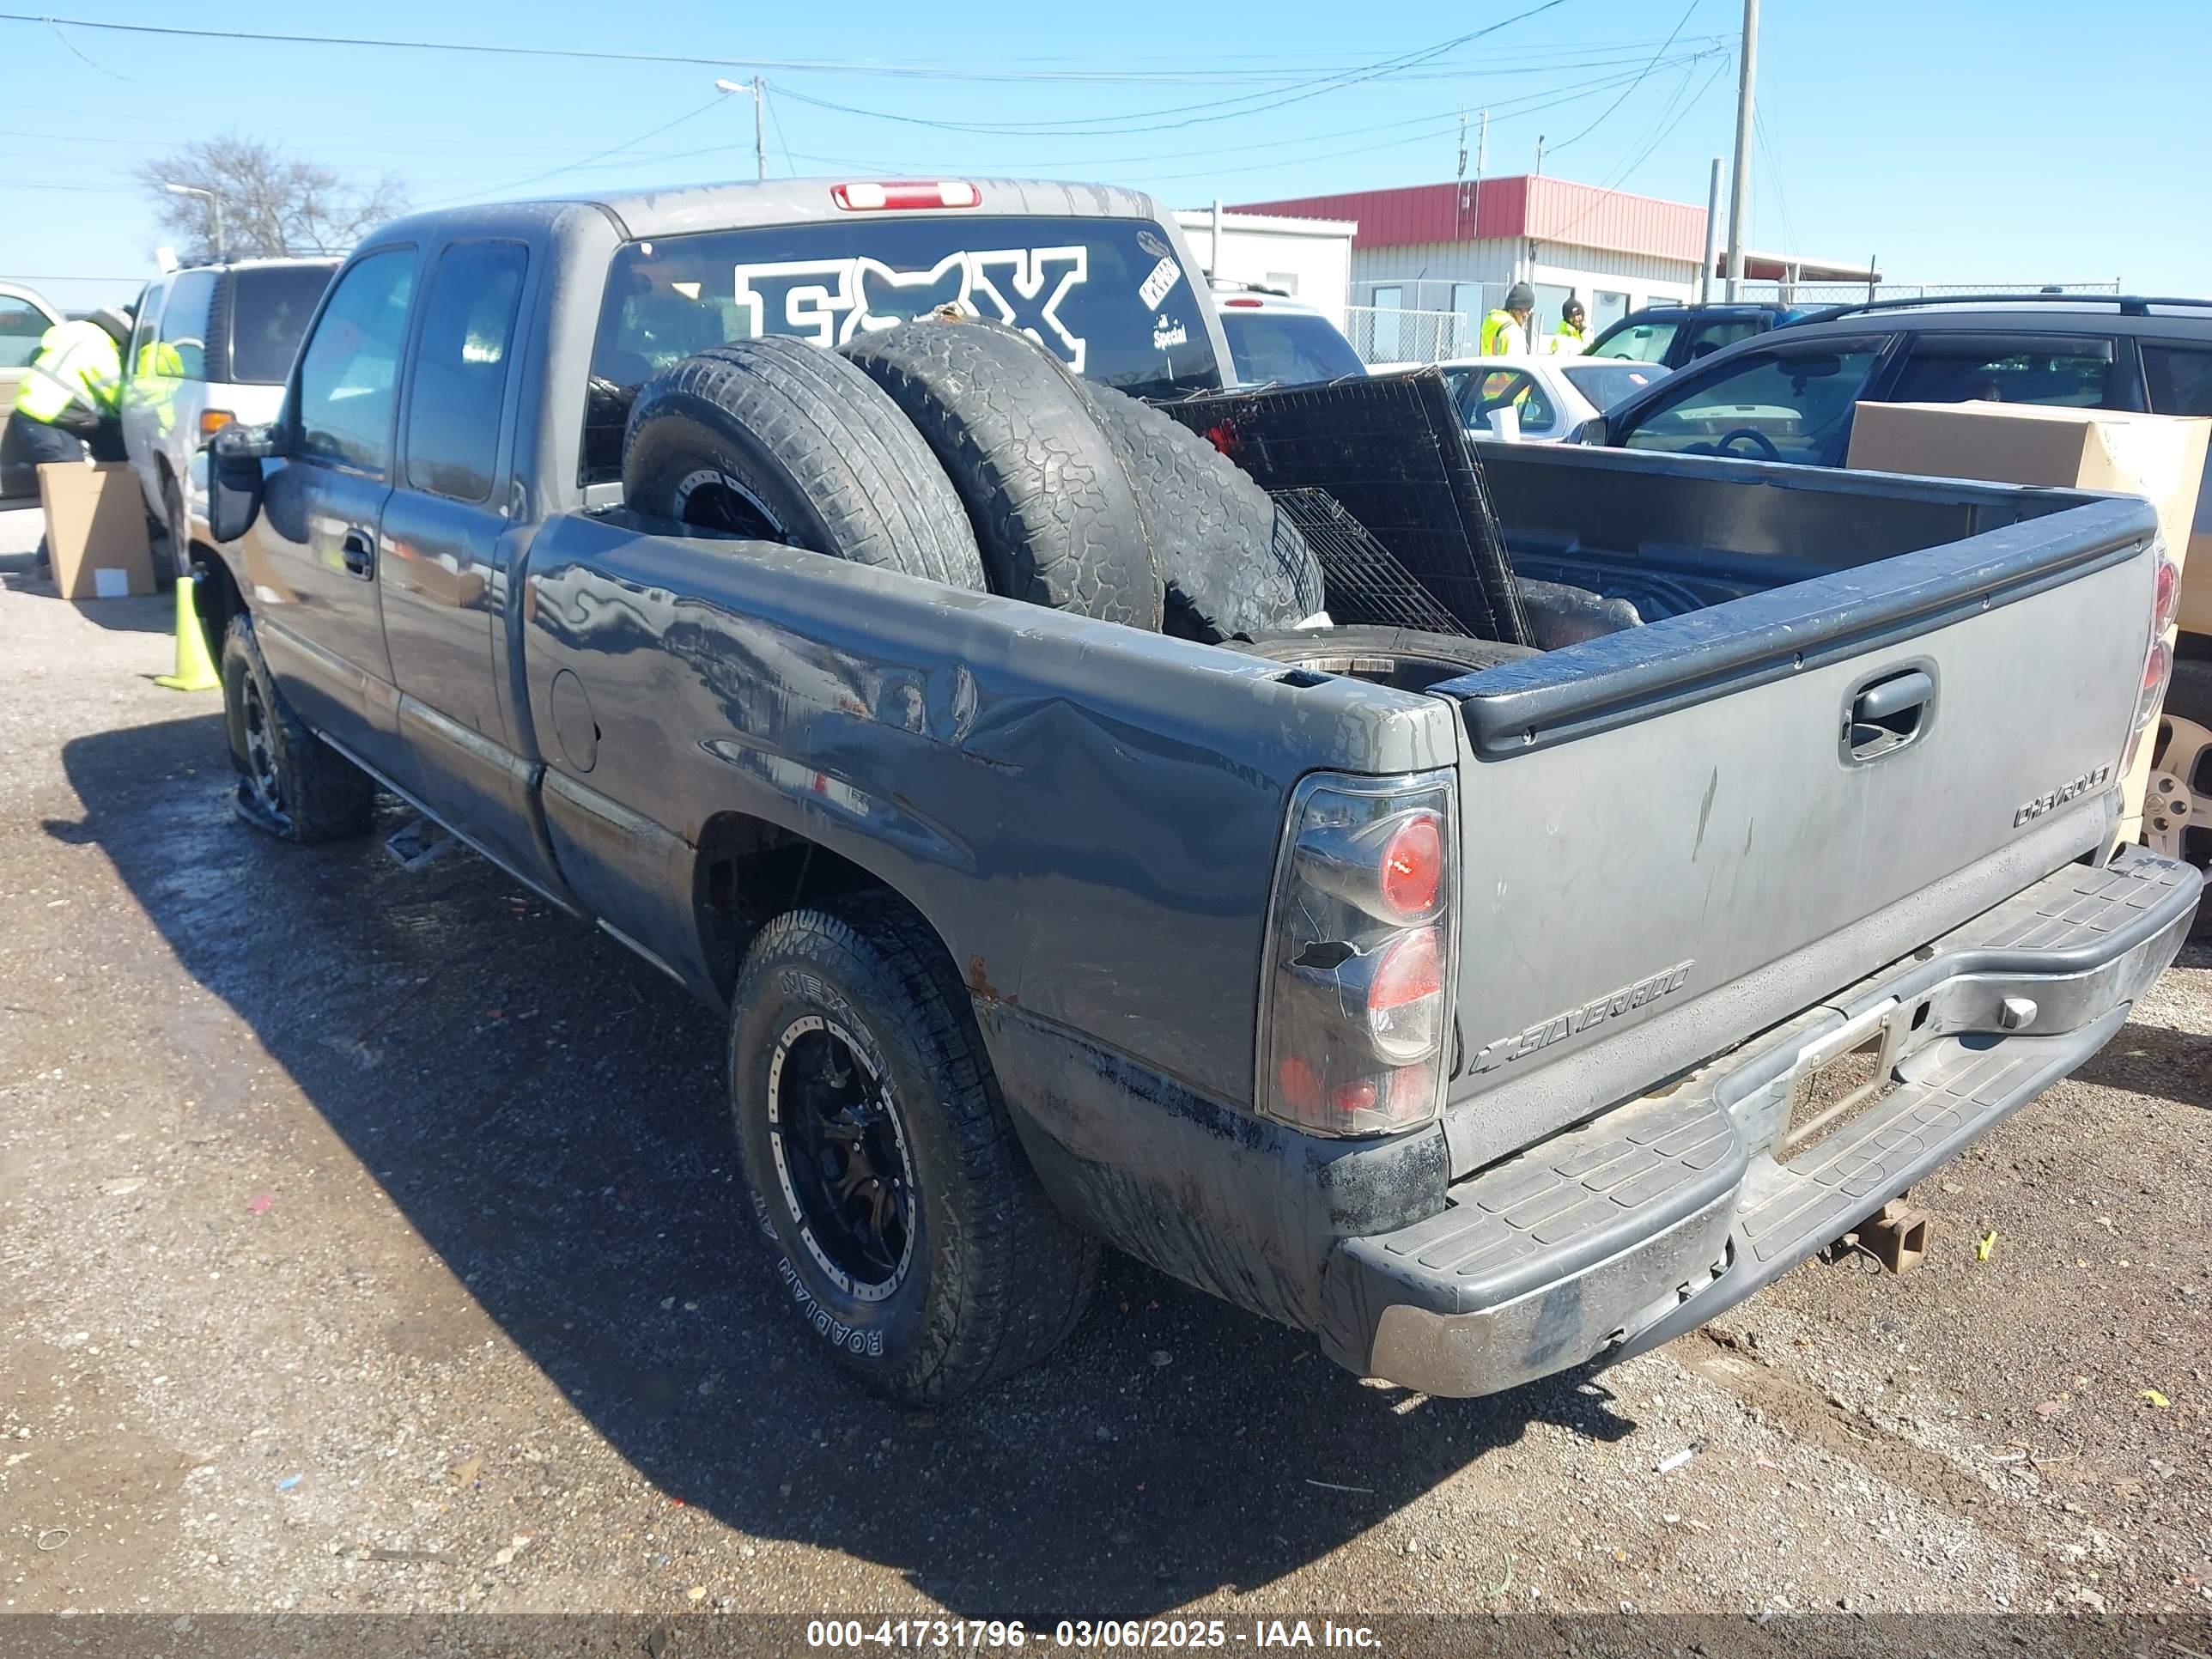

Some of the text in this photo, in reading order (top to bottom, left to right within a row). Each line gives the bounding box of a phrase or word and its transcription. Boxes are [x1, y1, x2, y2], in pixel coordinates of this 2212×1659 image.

[2013, 760, 2113, 829] CHEVROLET
[1513, 958, 1695, 1062] SILVERADO
[778, 1257, 883, 1355] ROADIAN
